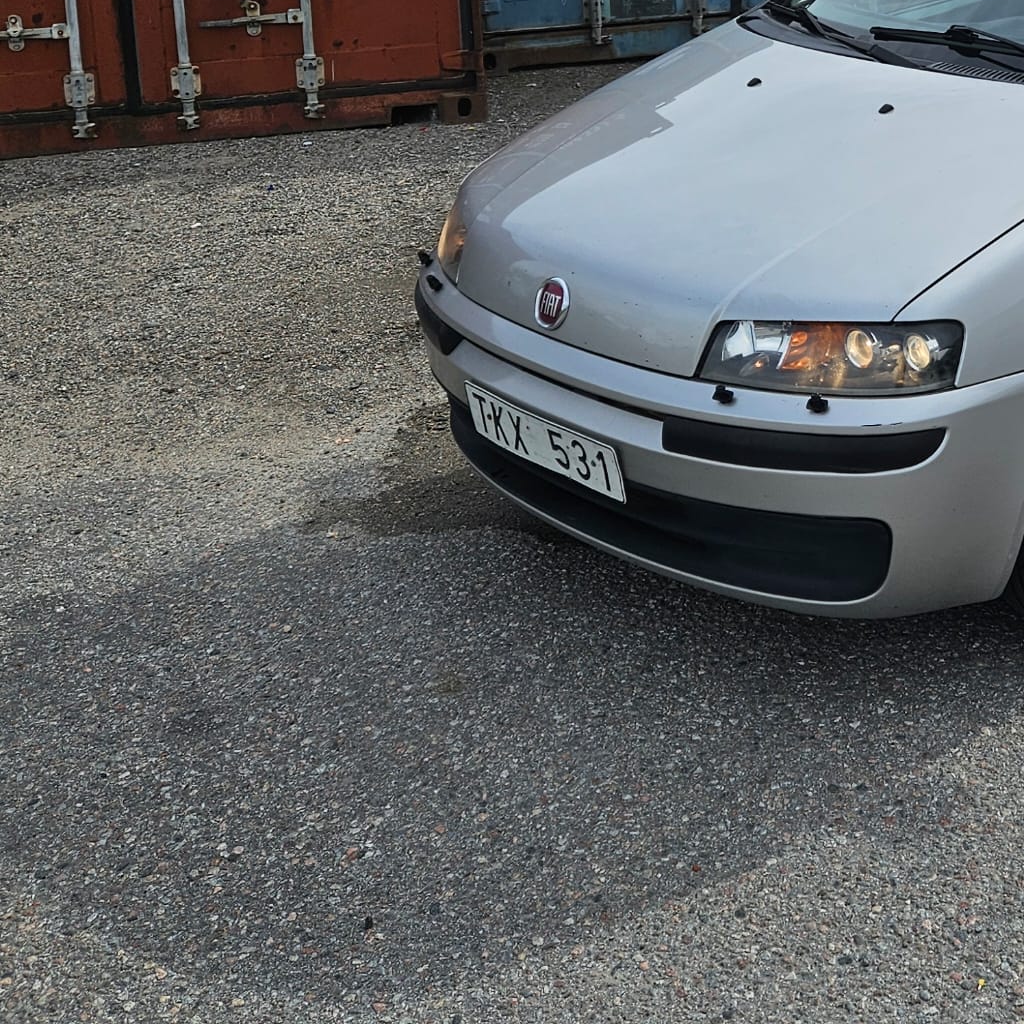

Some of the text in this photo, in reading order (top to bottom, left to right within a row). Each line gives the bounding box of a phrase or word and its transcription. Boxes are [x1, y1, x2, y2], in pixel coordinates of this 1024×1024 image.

[540, 290, 562, 318] FIAT
[471, 392, 612, 492] TKX 531
